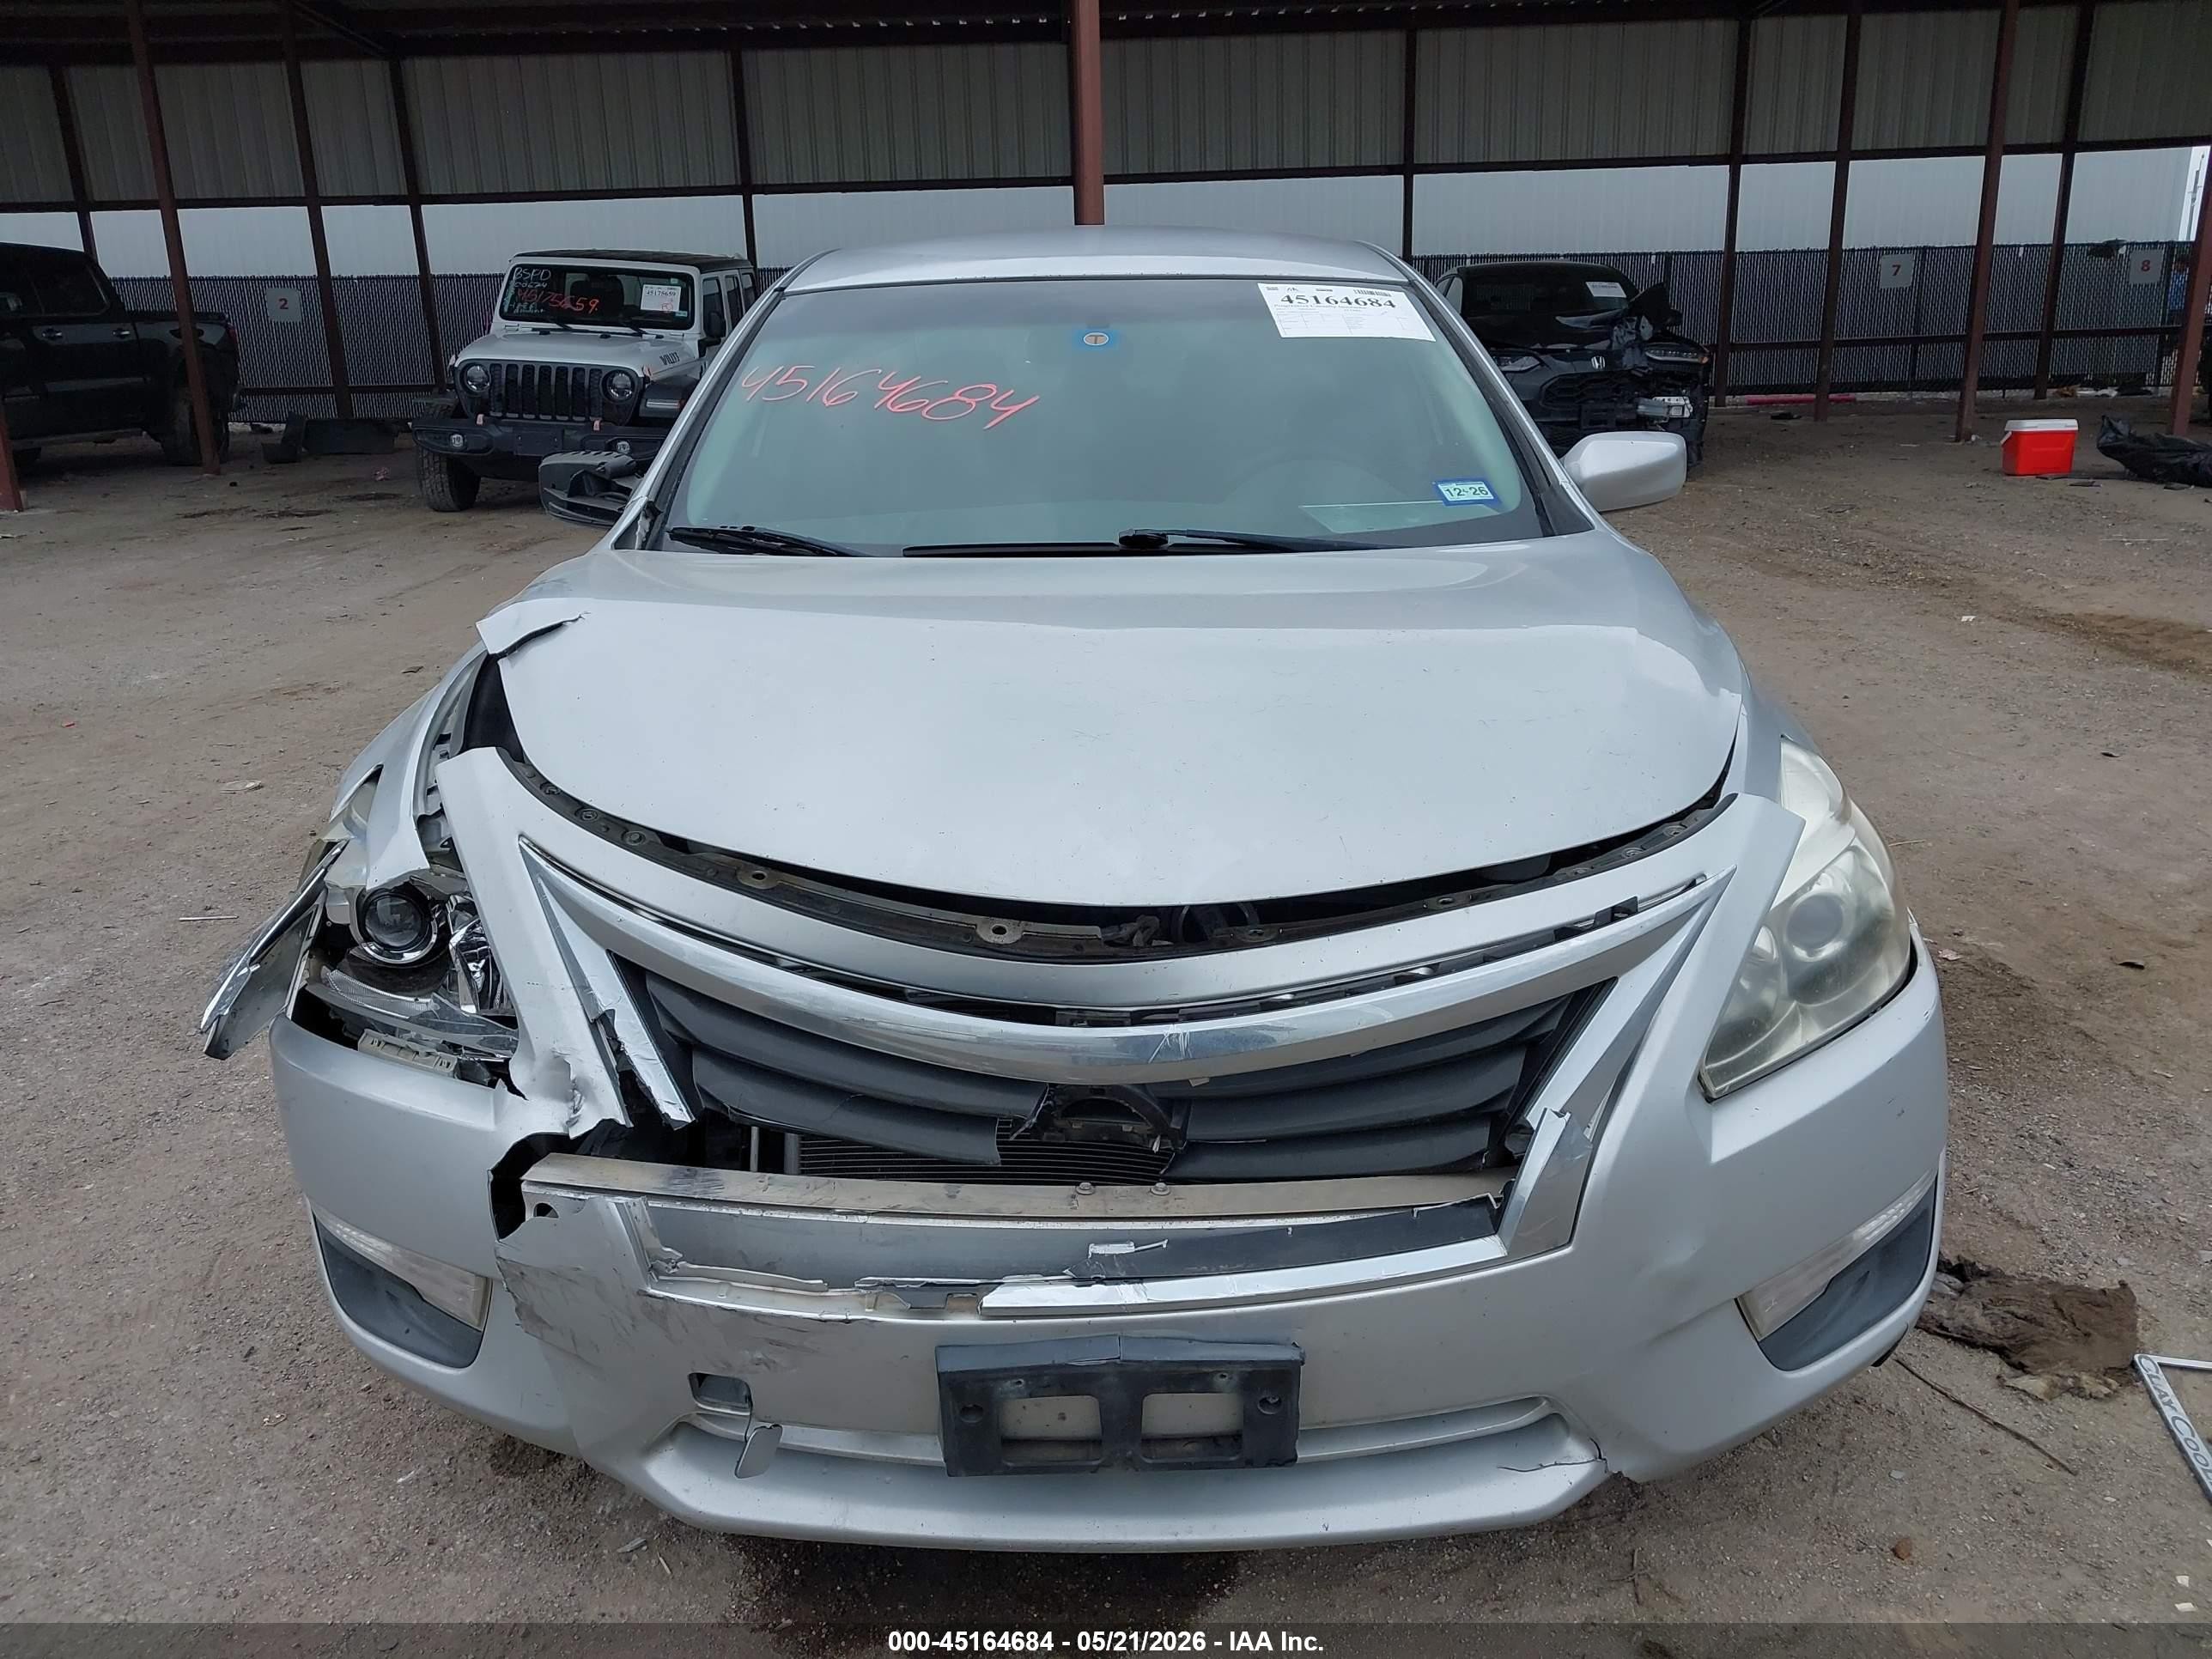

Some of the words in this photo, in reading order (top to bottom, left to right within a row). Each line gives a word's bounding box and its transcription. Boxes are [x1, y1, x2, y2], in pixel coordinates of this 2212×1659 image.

[1892, 264, 1902, 276] 7
[2140, 259, 2151, 271] 8
[278, 297, 289, 310] 2
[1280, 294, 1397, 308] 45164684
[742, 365, 1041, 430] 45164684
[2137, 1354, 2179, 1413] CLAY
[2171, 1415, 2212, 1486] COOL
